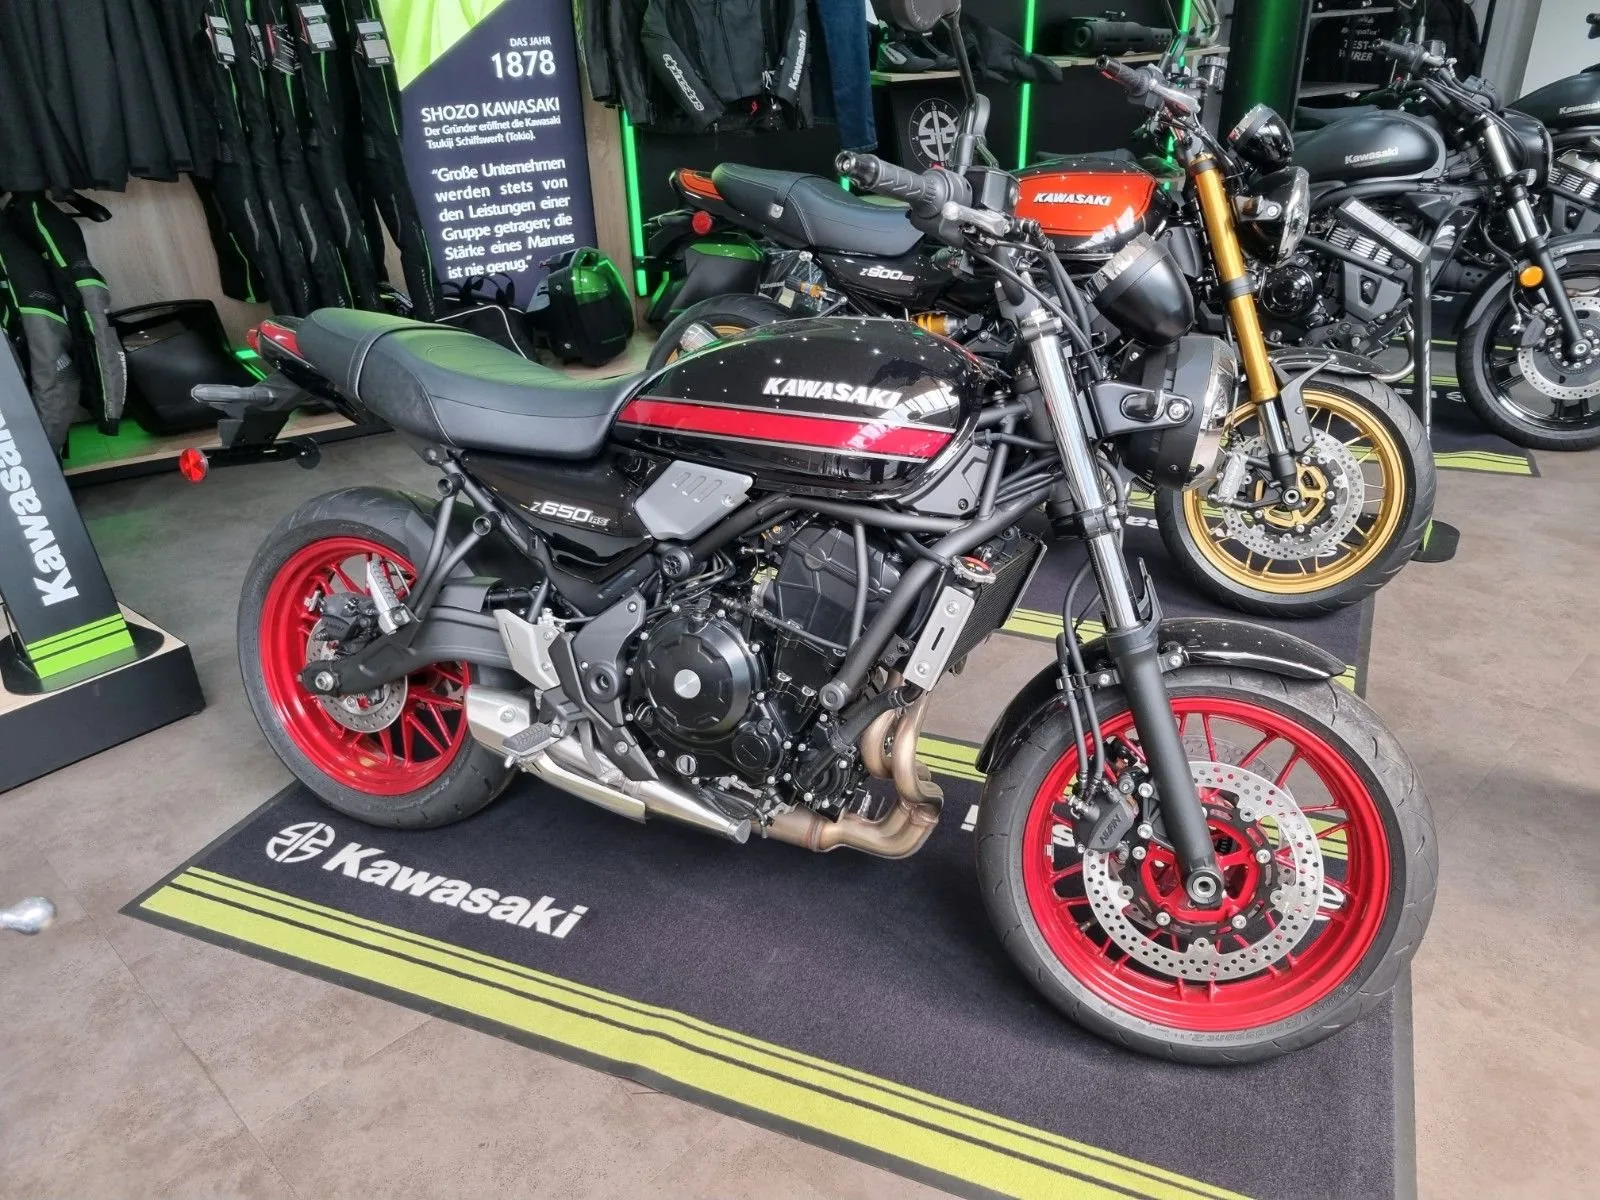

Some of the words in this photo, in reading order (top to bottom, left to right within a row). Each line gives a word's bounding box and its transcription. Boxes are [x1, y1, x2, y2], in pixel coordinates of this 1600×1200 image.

[509, 37, 528, 47] DAS
[529, 36, 552, 46] JAHR
[491, 49, 556, 79] 1878
[788, 29, 807, 91] Kawasaki
[421, 103, 479, 123] SHOZO
[482, 97, 560, 117] KAWASAKI
[1558, 101, 1600, 115] Kawasa
[424, 127, 441, 137] Der
[442, 122, 478, 135] Gründer
[479, 119, 511, 132] eröffnet
[511, 117, 525, 129] die
[525, 115, 561, 127] Kawasaki
[426, 137, 454, 150] Tsukiji
[455, 132, 504, 147] Schiffswerft
[505, 129, 536, 144] (Tokio).
[481, 158, 566, 178] Unternehmen
[1344, 146, 1399, 165] Kawasaki
[435, 185, 491, 203] werden
[500, 180, 534, 195] stets
[542, 177, 569, 190] von
[1033, 192, 1112, 207] KAWASAKI
[438, 208, 465, 222] den
[468, 200, 537, 219] Leistungen
[540, 195, 571, 210] einer
[441, 225, 492, 242] Gruppe
[494, 217, 551, 238] getragen;
[553, 212, 573, 228] die
[444, 243, 486, 261] Stärke
[490, 239, 523, 254] eines
[527, 233, 576, 249] Mannes
[447, 265, 463, 280] ist
[464, 262, 485, 277] nie
[762, 376, 903, 409] KAWASAKI
[0, 409, 80, 607] Kawasa
[321, 842, 590, 939] Kawasaki
